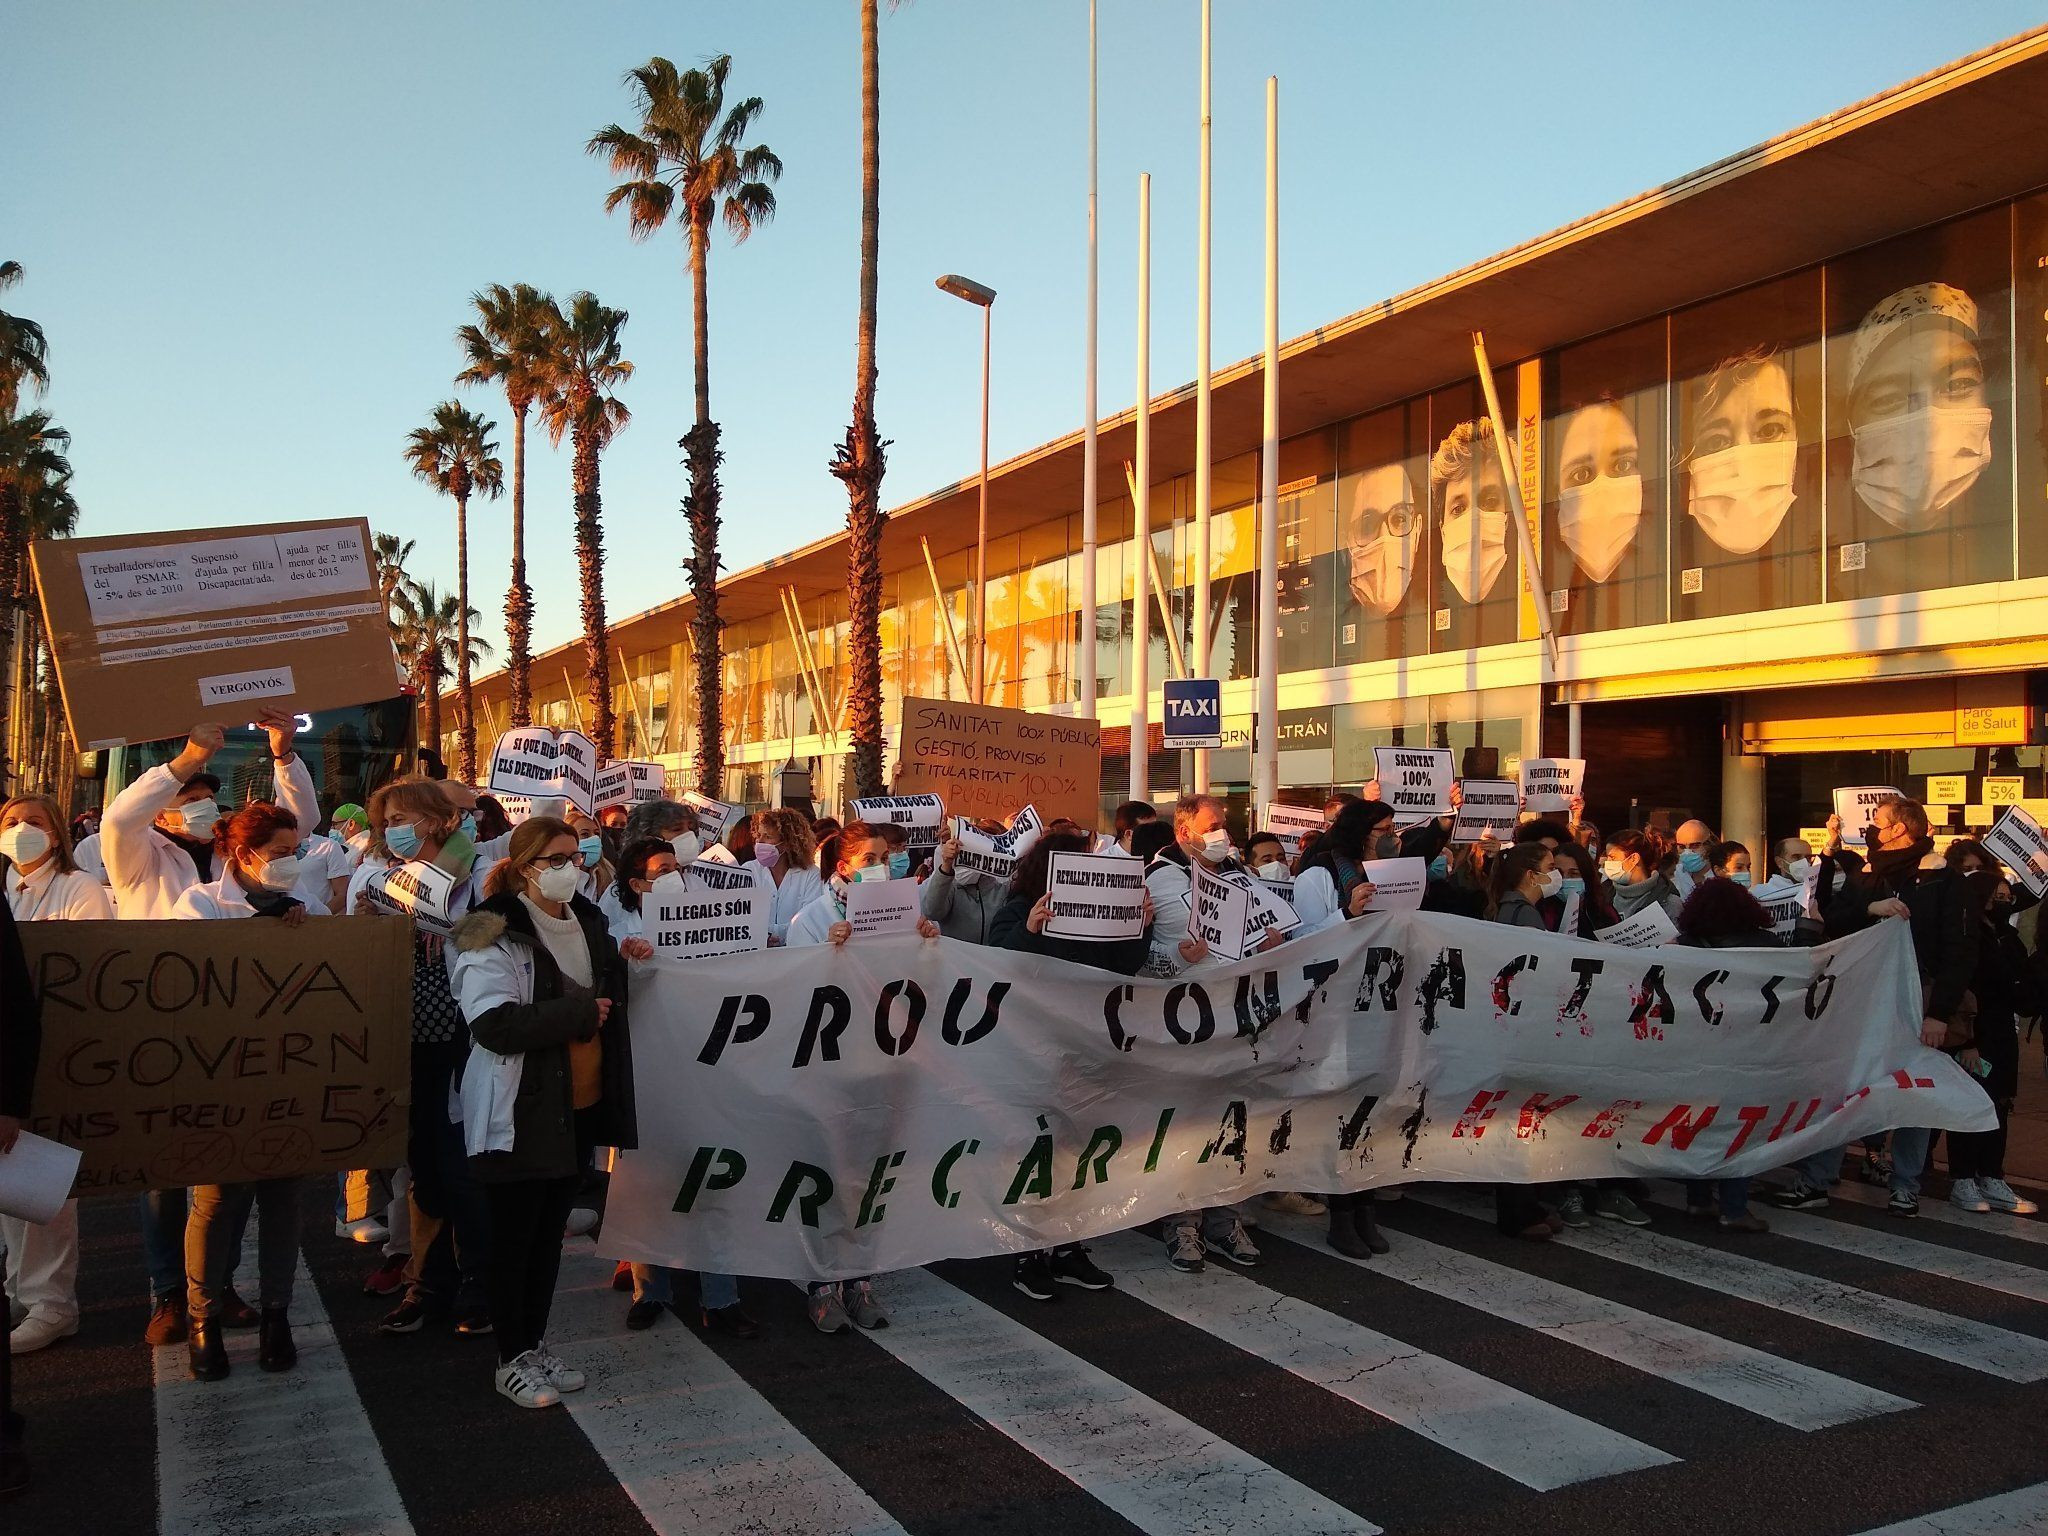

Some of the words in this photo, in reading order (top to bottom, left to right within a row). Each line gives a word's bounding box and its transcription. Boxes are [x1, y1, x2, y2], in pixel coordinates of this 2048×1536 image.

[1524, 414, 1537, 471] MASK
[286, 545, 309, 557] ajuda
[316, 543, 330, 554] per
[90, 559, 177, 575] Treballadors/ores
[288, 559, 315, 568] menor
[317, 555, 328, 565] de
[331, 554, 337, 563] 2
[340, 553, 359, 565] anys
[194, 565, 228, 579] d'ajuda
[232, 565, 247, 576] per
[290, 571, 305, 581] des
[306, 569, 317, 579] de
[94, 578, 110, 589] del
[105, 590, 123, 601] 5%
[127, 588, 142, 598] des
[145, 586, 157, 596] de
[161, 583, 183, 595] 2010
[180, 624, 192, 633] del
[198, 619, 233, 630] Parlament
[235, 617, 243, 626] de
[315, 609, 326, 618] que
[172, 643, 202, 654] perceben
[203, 641, 224, 650] dietes
[300, 629, 312, 638] que
[1167, 698, 1218, 717] TAXI
[1963, 707, 1992, 719] Parc
[915, 707, 1003, 736] SANITAT
[1277, 717, 1329, 739] LTRÁN
[1962, 718, 1979, 731] de
[1983, 717, 2017, 730] Salut
[523, 739, 540, 754] QUE
[1172, 739, 1184, 747] Taxi
[985, 745, 1047, 766] PROVISIÓ
[1394, 753, 1435, 768] SANITAT
[497, 758, 515, 775] ELS
[514, 760, 552, 781] DERIVEM
[559, 765, 570, 779] LA
[1402, 770, 1432, 787] 100%
[1529, 767, 1570, 780] NECESSITEM
[1019, 772, 1077, 796] 100%
[1525, 782, 1536, 796] MÉS
[1537, 783, 1575, 795] PERSONAL
[1989, 785, 2016, 801] 5%
[893, 794, 936, 809] NEGOCIS
[1392, 788, 1436, 806] PÚBLICA
[958, 850, 982, 868] SALUT
[982, 855, 993, 871] DE
[993, 857, 1009, 876] LES
[1055, 869, 1091, 886] RETALLEN
[1091, 871, 1106, 888] PER
[660, 903, 721, 922] IL.LEGALS
[727, 898, 752, 916] SÓN
[1052, 901, 1097, 920] PRIVATITZEN
[1097, 904, 1111, 920] PER
[868, 915, 894, 924] CENTRES
[1623, 923, 1640, 934] SOM
[658, 931, 681, 947] LES
[684, 925, 752, 946] FACTURES,
[1624, 931, 1662, 948] BALLANT!!
[1633, 923, 1657, 938] ESTAN
[40, 949, 363, 1019] RGONYA
[696, 978, 1012, 1069] PROU
[64, 1027, 369, 1087] GOVERN
[136, 1102, 245, 1134] TREU
[267, 1097, 305, 1121] EL
[320, 1086, 397, 1154] 5%
[672, 1101, 1248, 1229] PRECÀRIA
